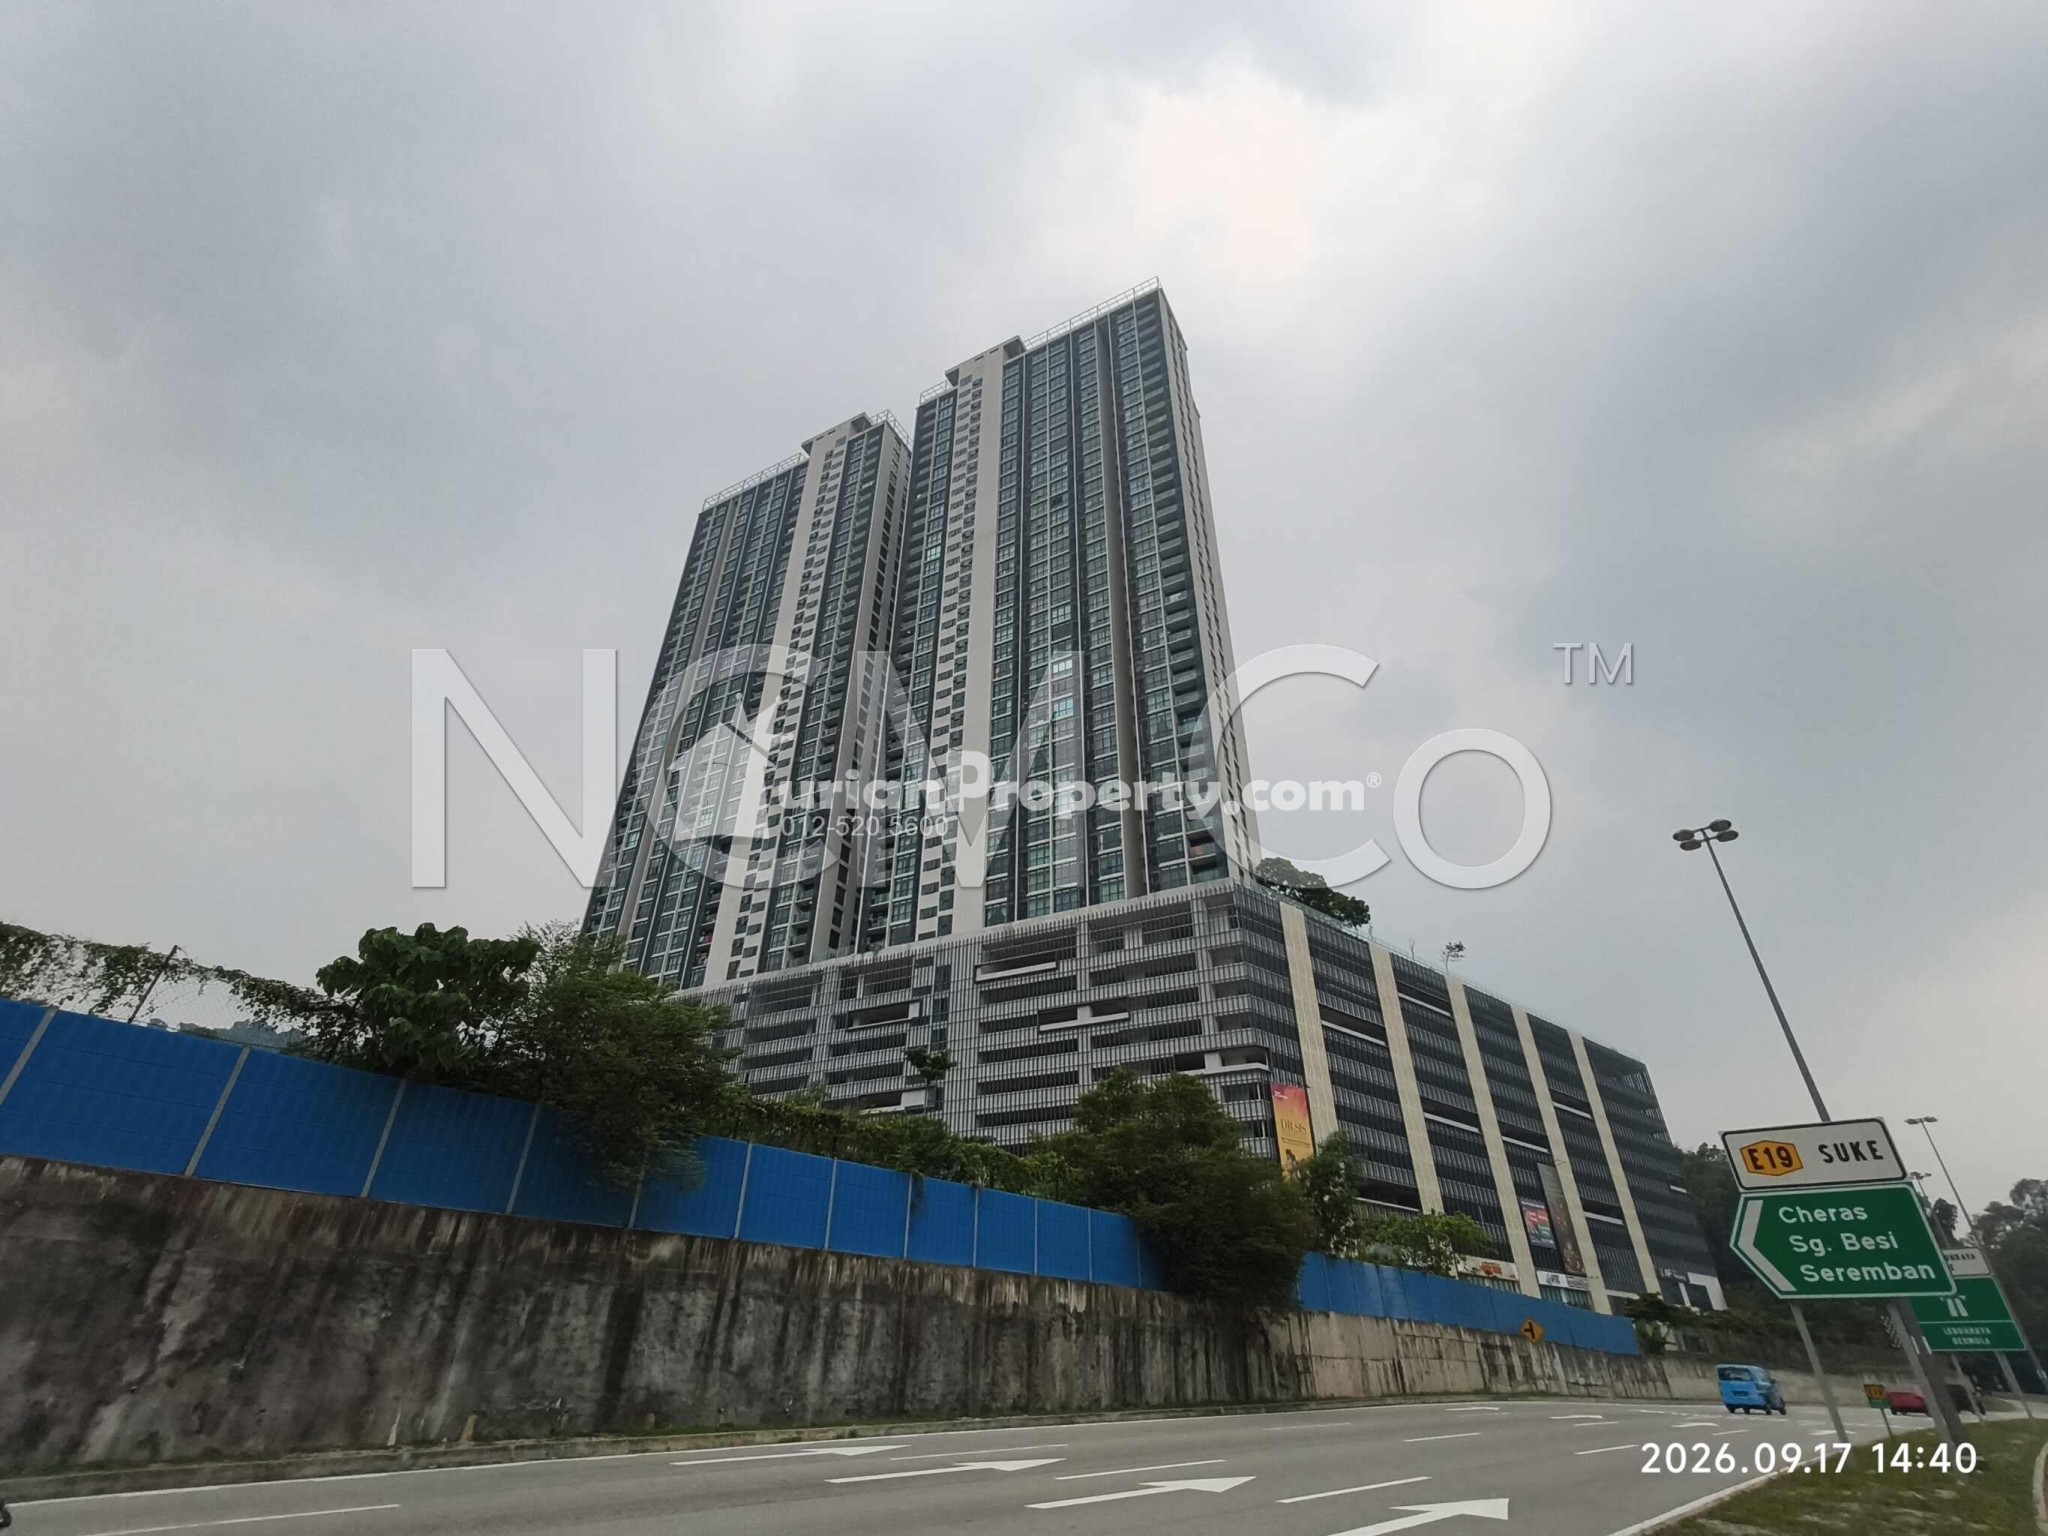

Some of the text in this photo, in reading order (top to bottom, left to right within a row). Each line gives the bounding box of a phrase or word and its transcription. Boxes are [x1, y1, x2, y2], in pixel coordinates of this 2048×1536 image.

[1747, 1140, 1884, 1171] E19 SUKE
[1778, 1206, 1868, 1224] Cheras
[1789, 1231, 1898, 1257] Sg. Besi
[1800, 1262, 1936, 1282] Seremban
